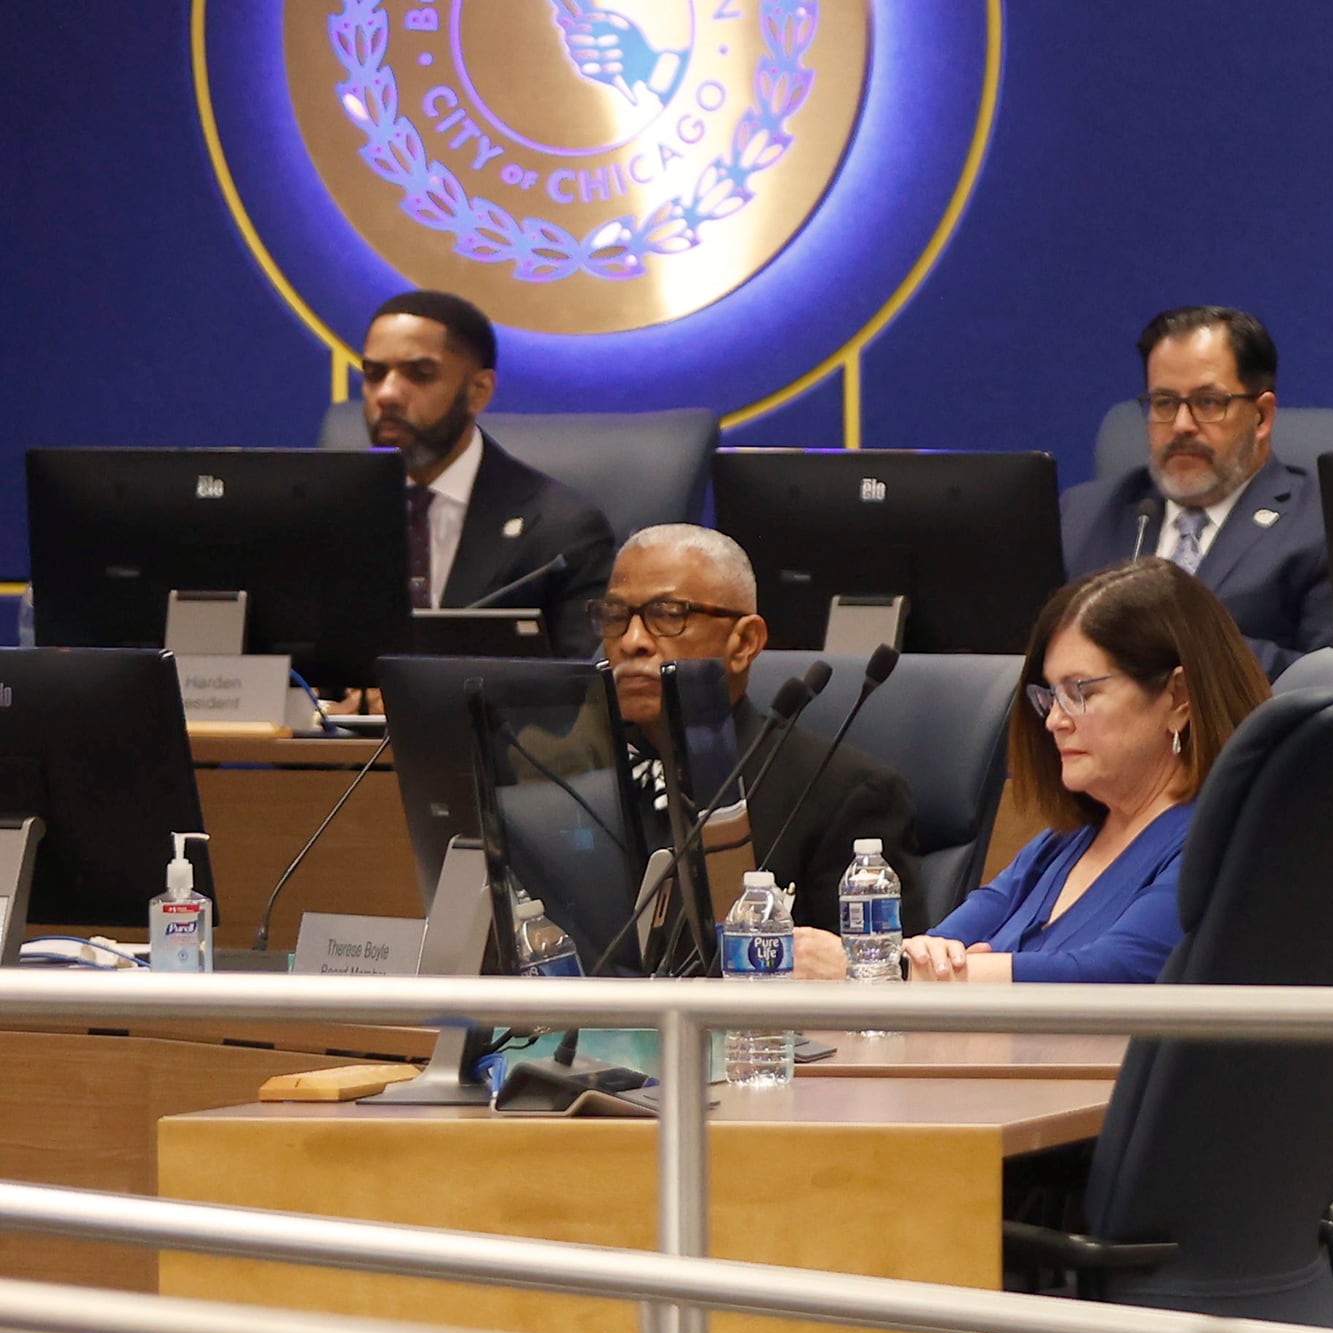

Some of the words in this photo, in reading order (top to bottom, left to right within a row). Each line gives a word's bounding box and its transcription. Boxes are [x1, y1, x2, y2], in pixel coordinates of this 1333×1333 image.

[421, 85, 504, 170] CITY
[545, 80, 726, 204] CHICAGO
[328, 938, 362, 958] Therese
[364, 940, 390, 961] Boyle
[754, 936, 779, 948] Pure
[757, 947, 777, 961] Life
